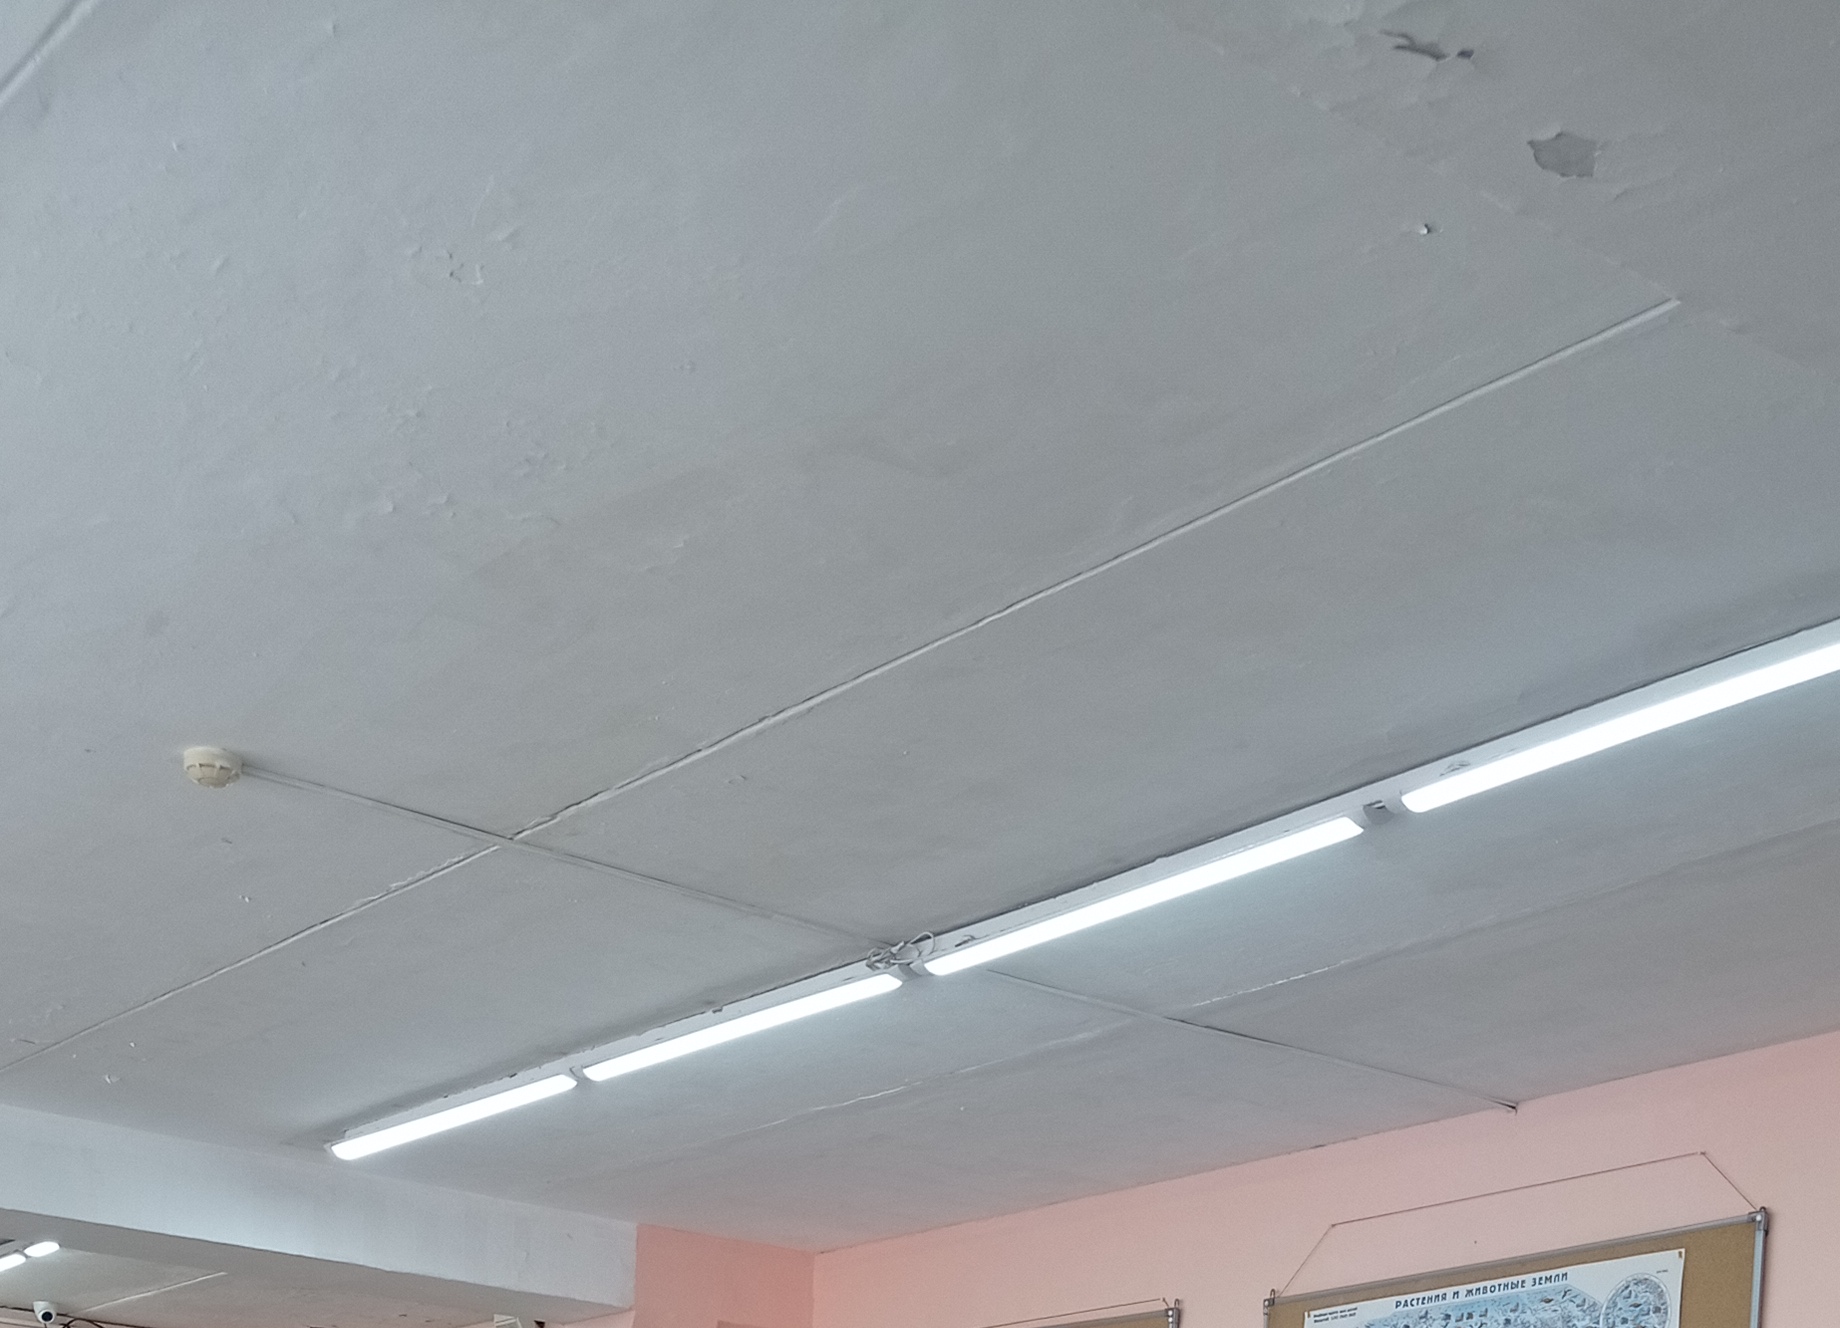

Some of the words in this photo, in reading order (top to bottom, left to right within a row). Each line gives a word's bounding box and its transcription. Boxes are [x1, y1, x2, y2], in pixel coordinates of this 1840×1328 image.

[1395, 1292, 1447, 1309] РАСТЕНИЯ
[1453, 1291, 1460, 1299] И
[1465, 1280, 1526, 1298] ЖИВОТНЫЕ
[1531, 1272, 1568, 1286] ЗЕМЛИ
